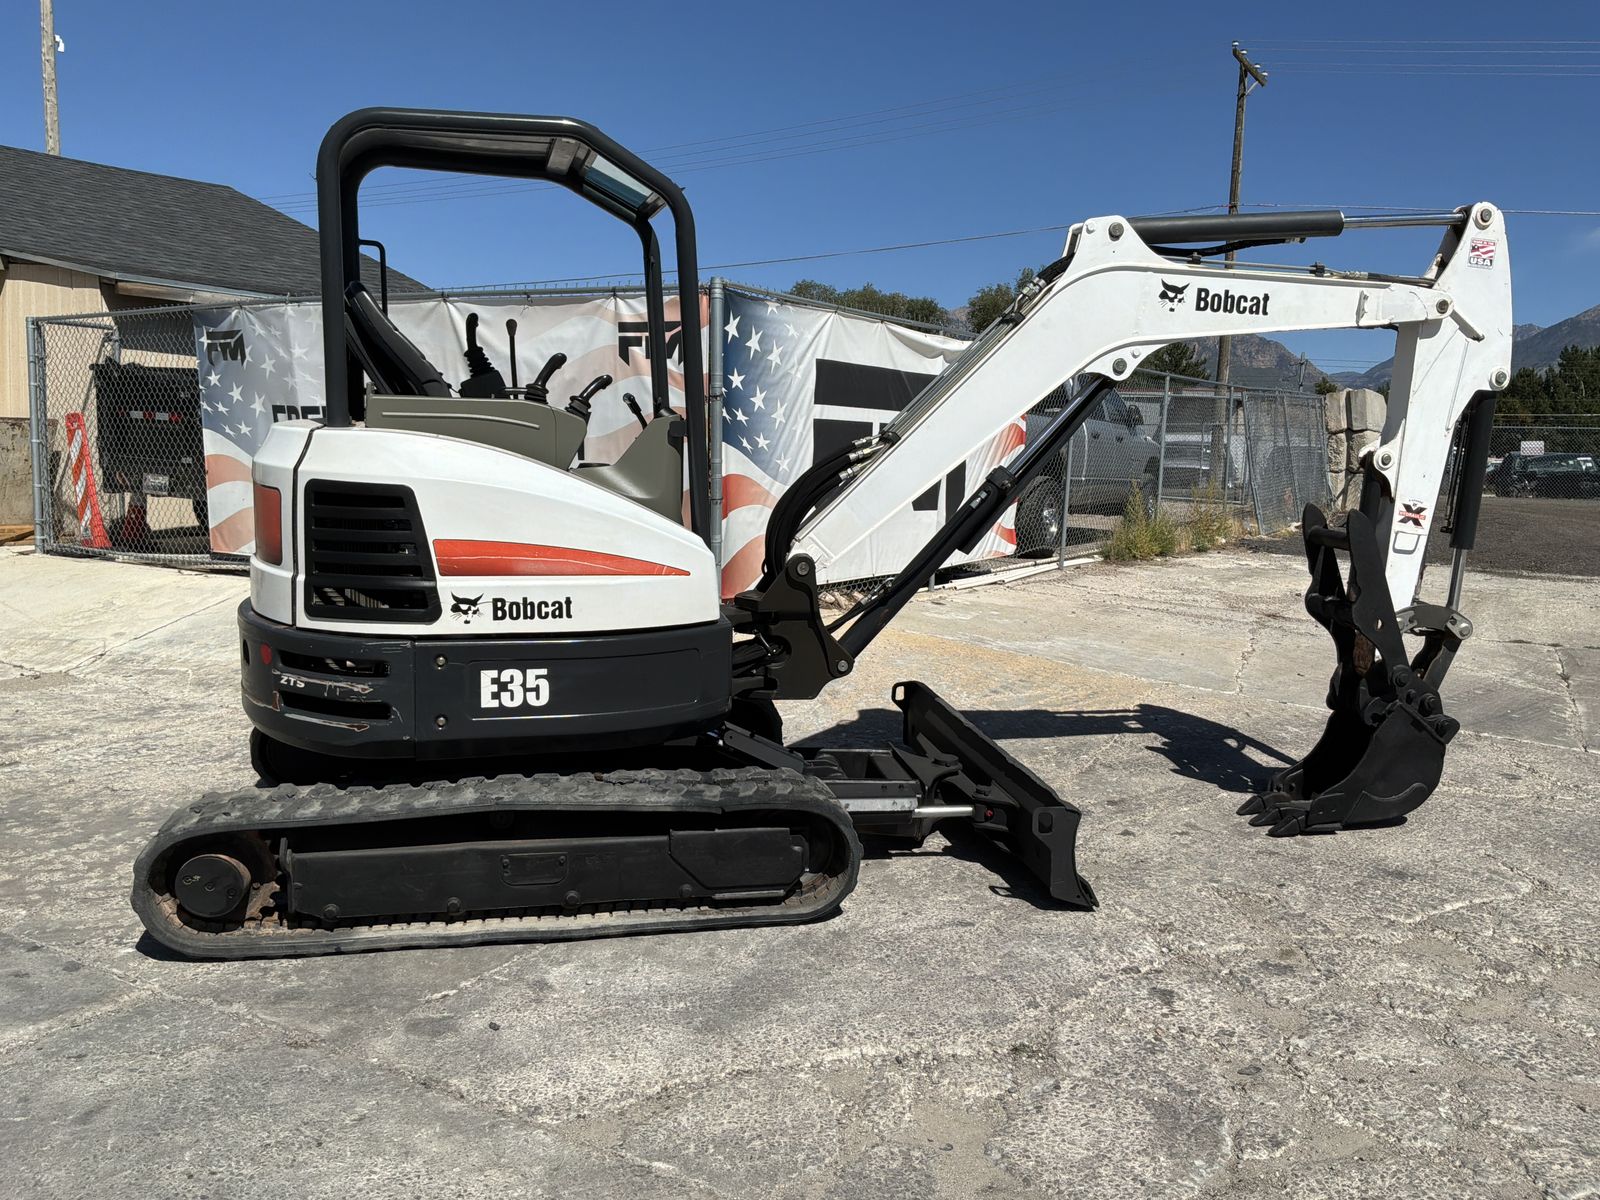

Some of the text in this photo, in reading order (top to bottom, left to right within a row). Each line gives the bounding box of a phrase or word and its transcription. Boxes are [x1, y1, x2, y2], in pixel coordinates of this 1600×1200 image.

[1470, 257, 1491, 266] USA
[1195, 286, 1270, 316] Bobcat
[492, 596, 573, 621] Bobcat
[280, 675, 305, 688] ZTS
[480, 668, 550, 708] E35
